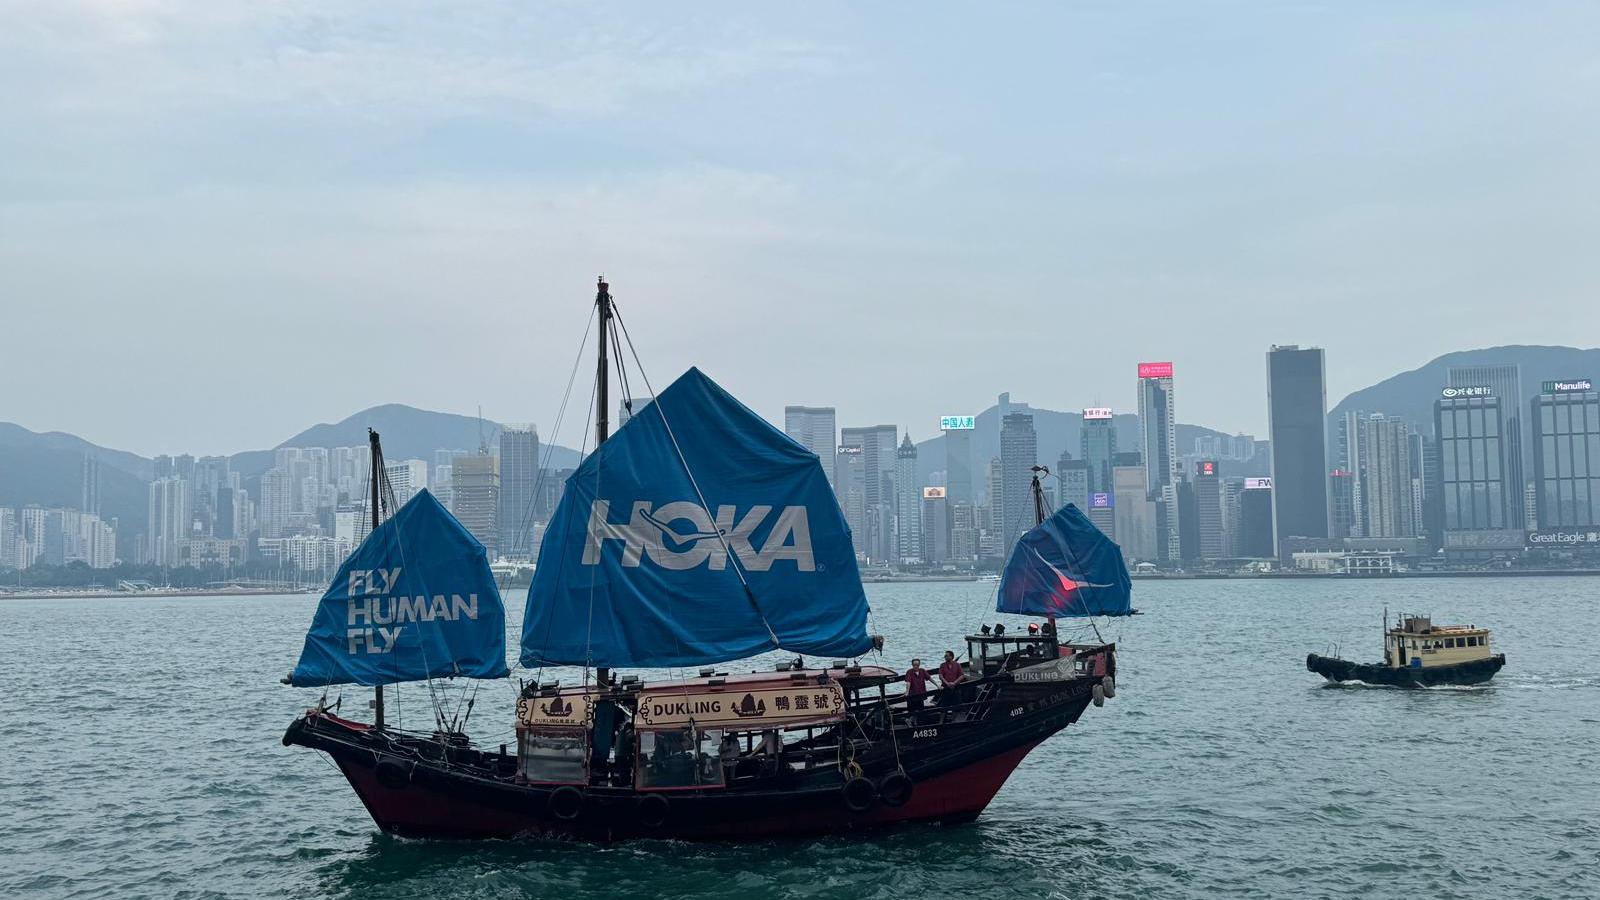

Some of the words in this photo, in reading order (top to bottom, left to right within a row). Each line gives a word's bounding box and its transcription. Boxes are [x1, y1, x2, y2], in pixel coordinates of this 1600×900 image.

[1554, 381, 1591, 390] Manulife
[581, 500, 816, 572] HOKA
[1529, 532, 1556, 543] Great
[1557, 531, 1585, 545] Eagle
[348, 567, 402, 596] FLY
[347, 594, 478, 625] HUMAN
[347, 626, 402, 655] FLY
[653, 701, 721, 716] DUKLING
[775, 694, 829, 711] 鴨靈號
[912, 728, 938, 739] A4833
